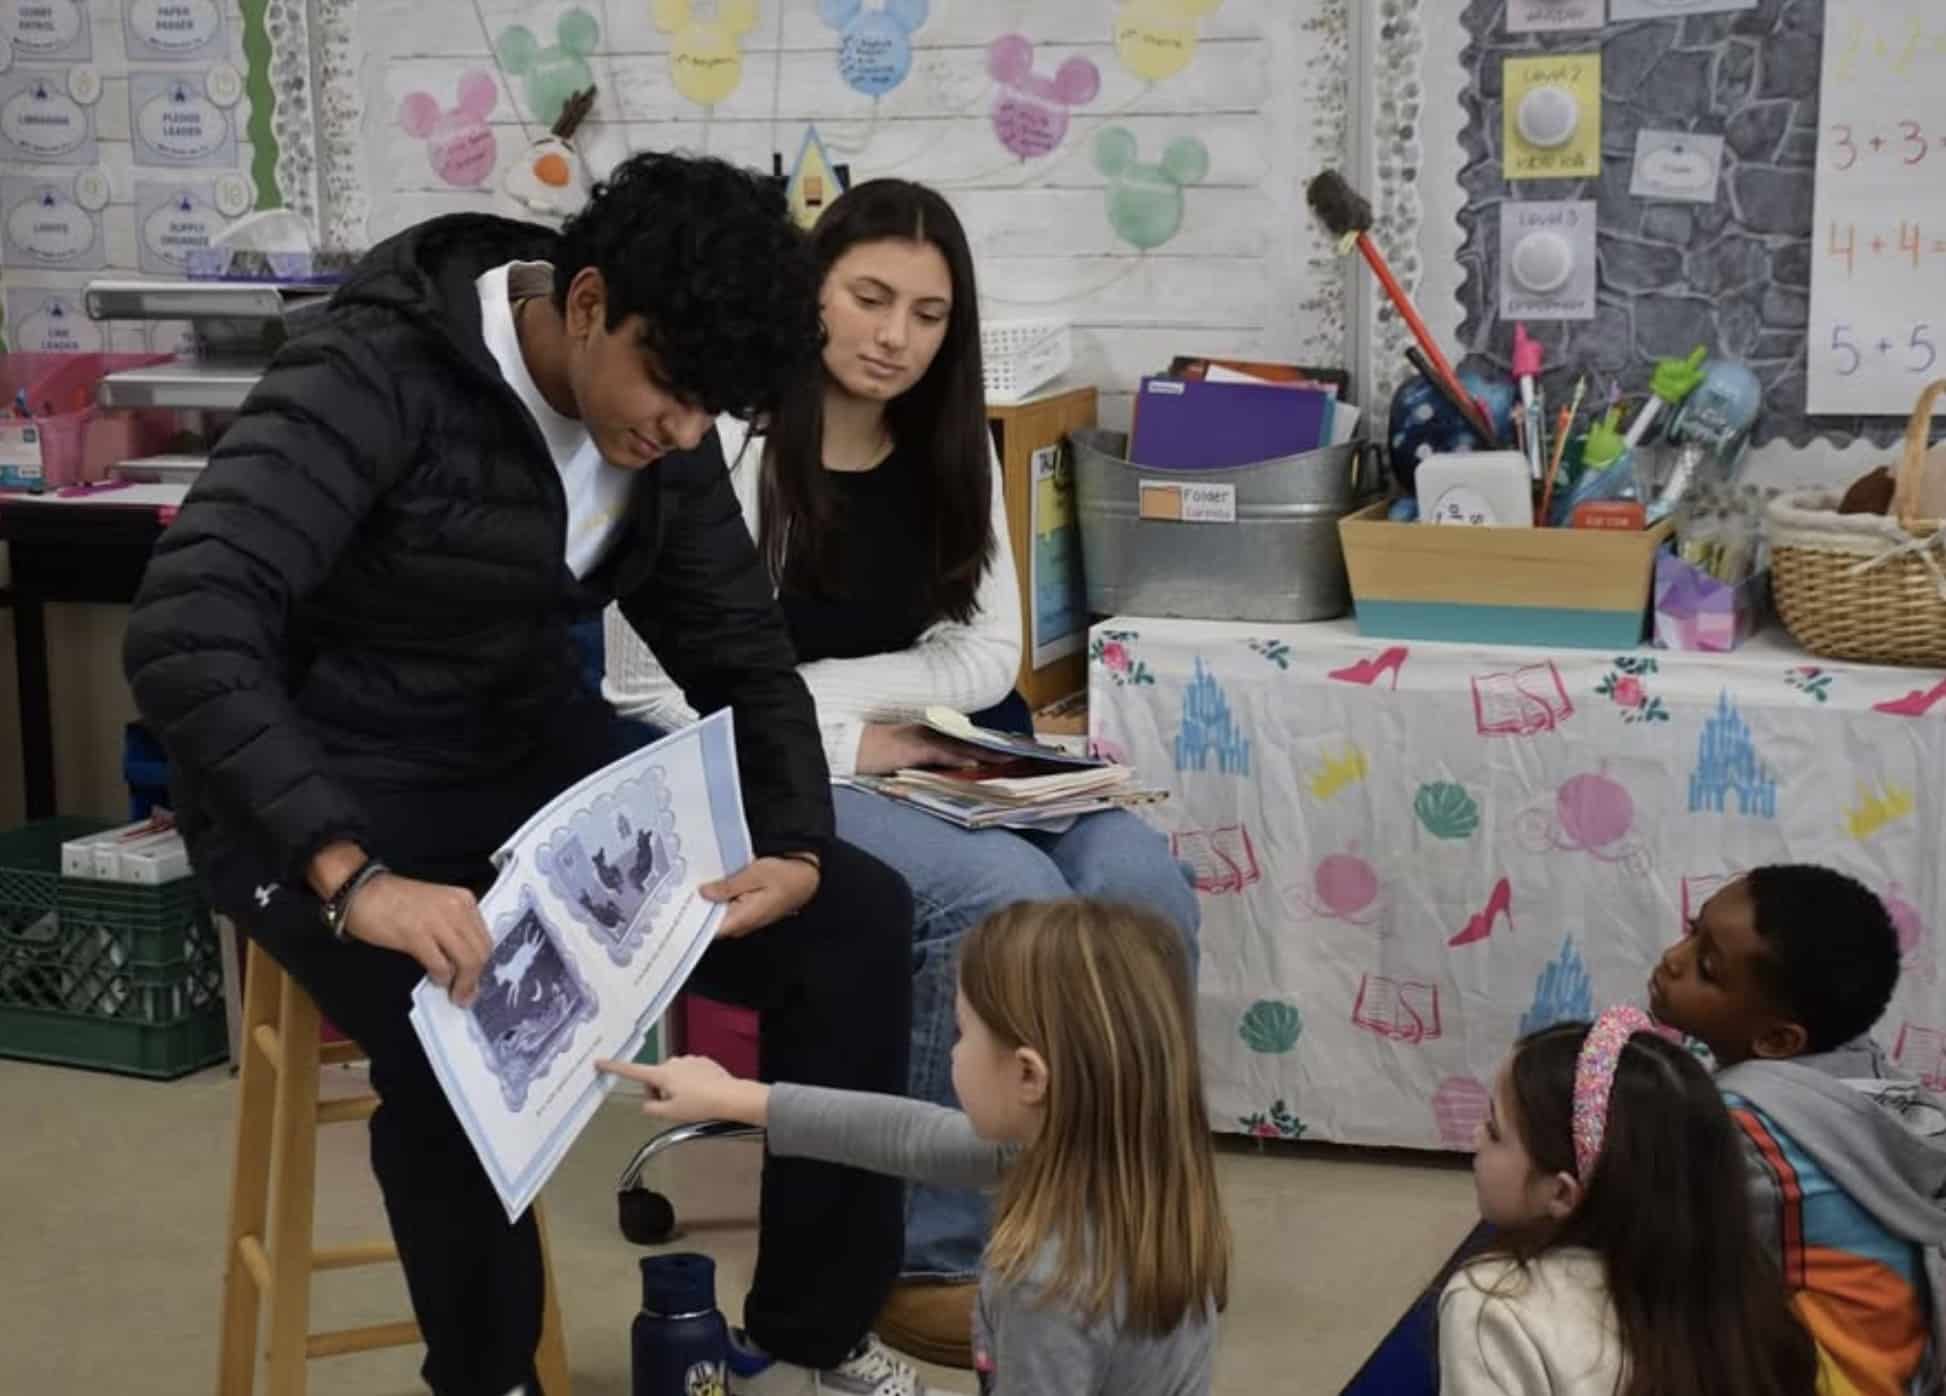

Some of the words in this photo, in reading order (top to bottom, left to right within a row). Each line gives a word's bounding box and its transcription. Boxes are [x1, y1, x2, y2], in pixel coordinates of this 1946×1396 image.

[1831, 123, 1858, 171] 3
[1897, 120, 1929, 166] 3
[1828, 219, 1857, 278] 4
[1898, 219, 1921, 271] 4
[1831, 324, 1862, 376] 5
[1904, 323, 1938, 374] 5
